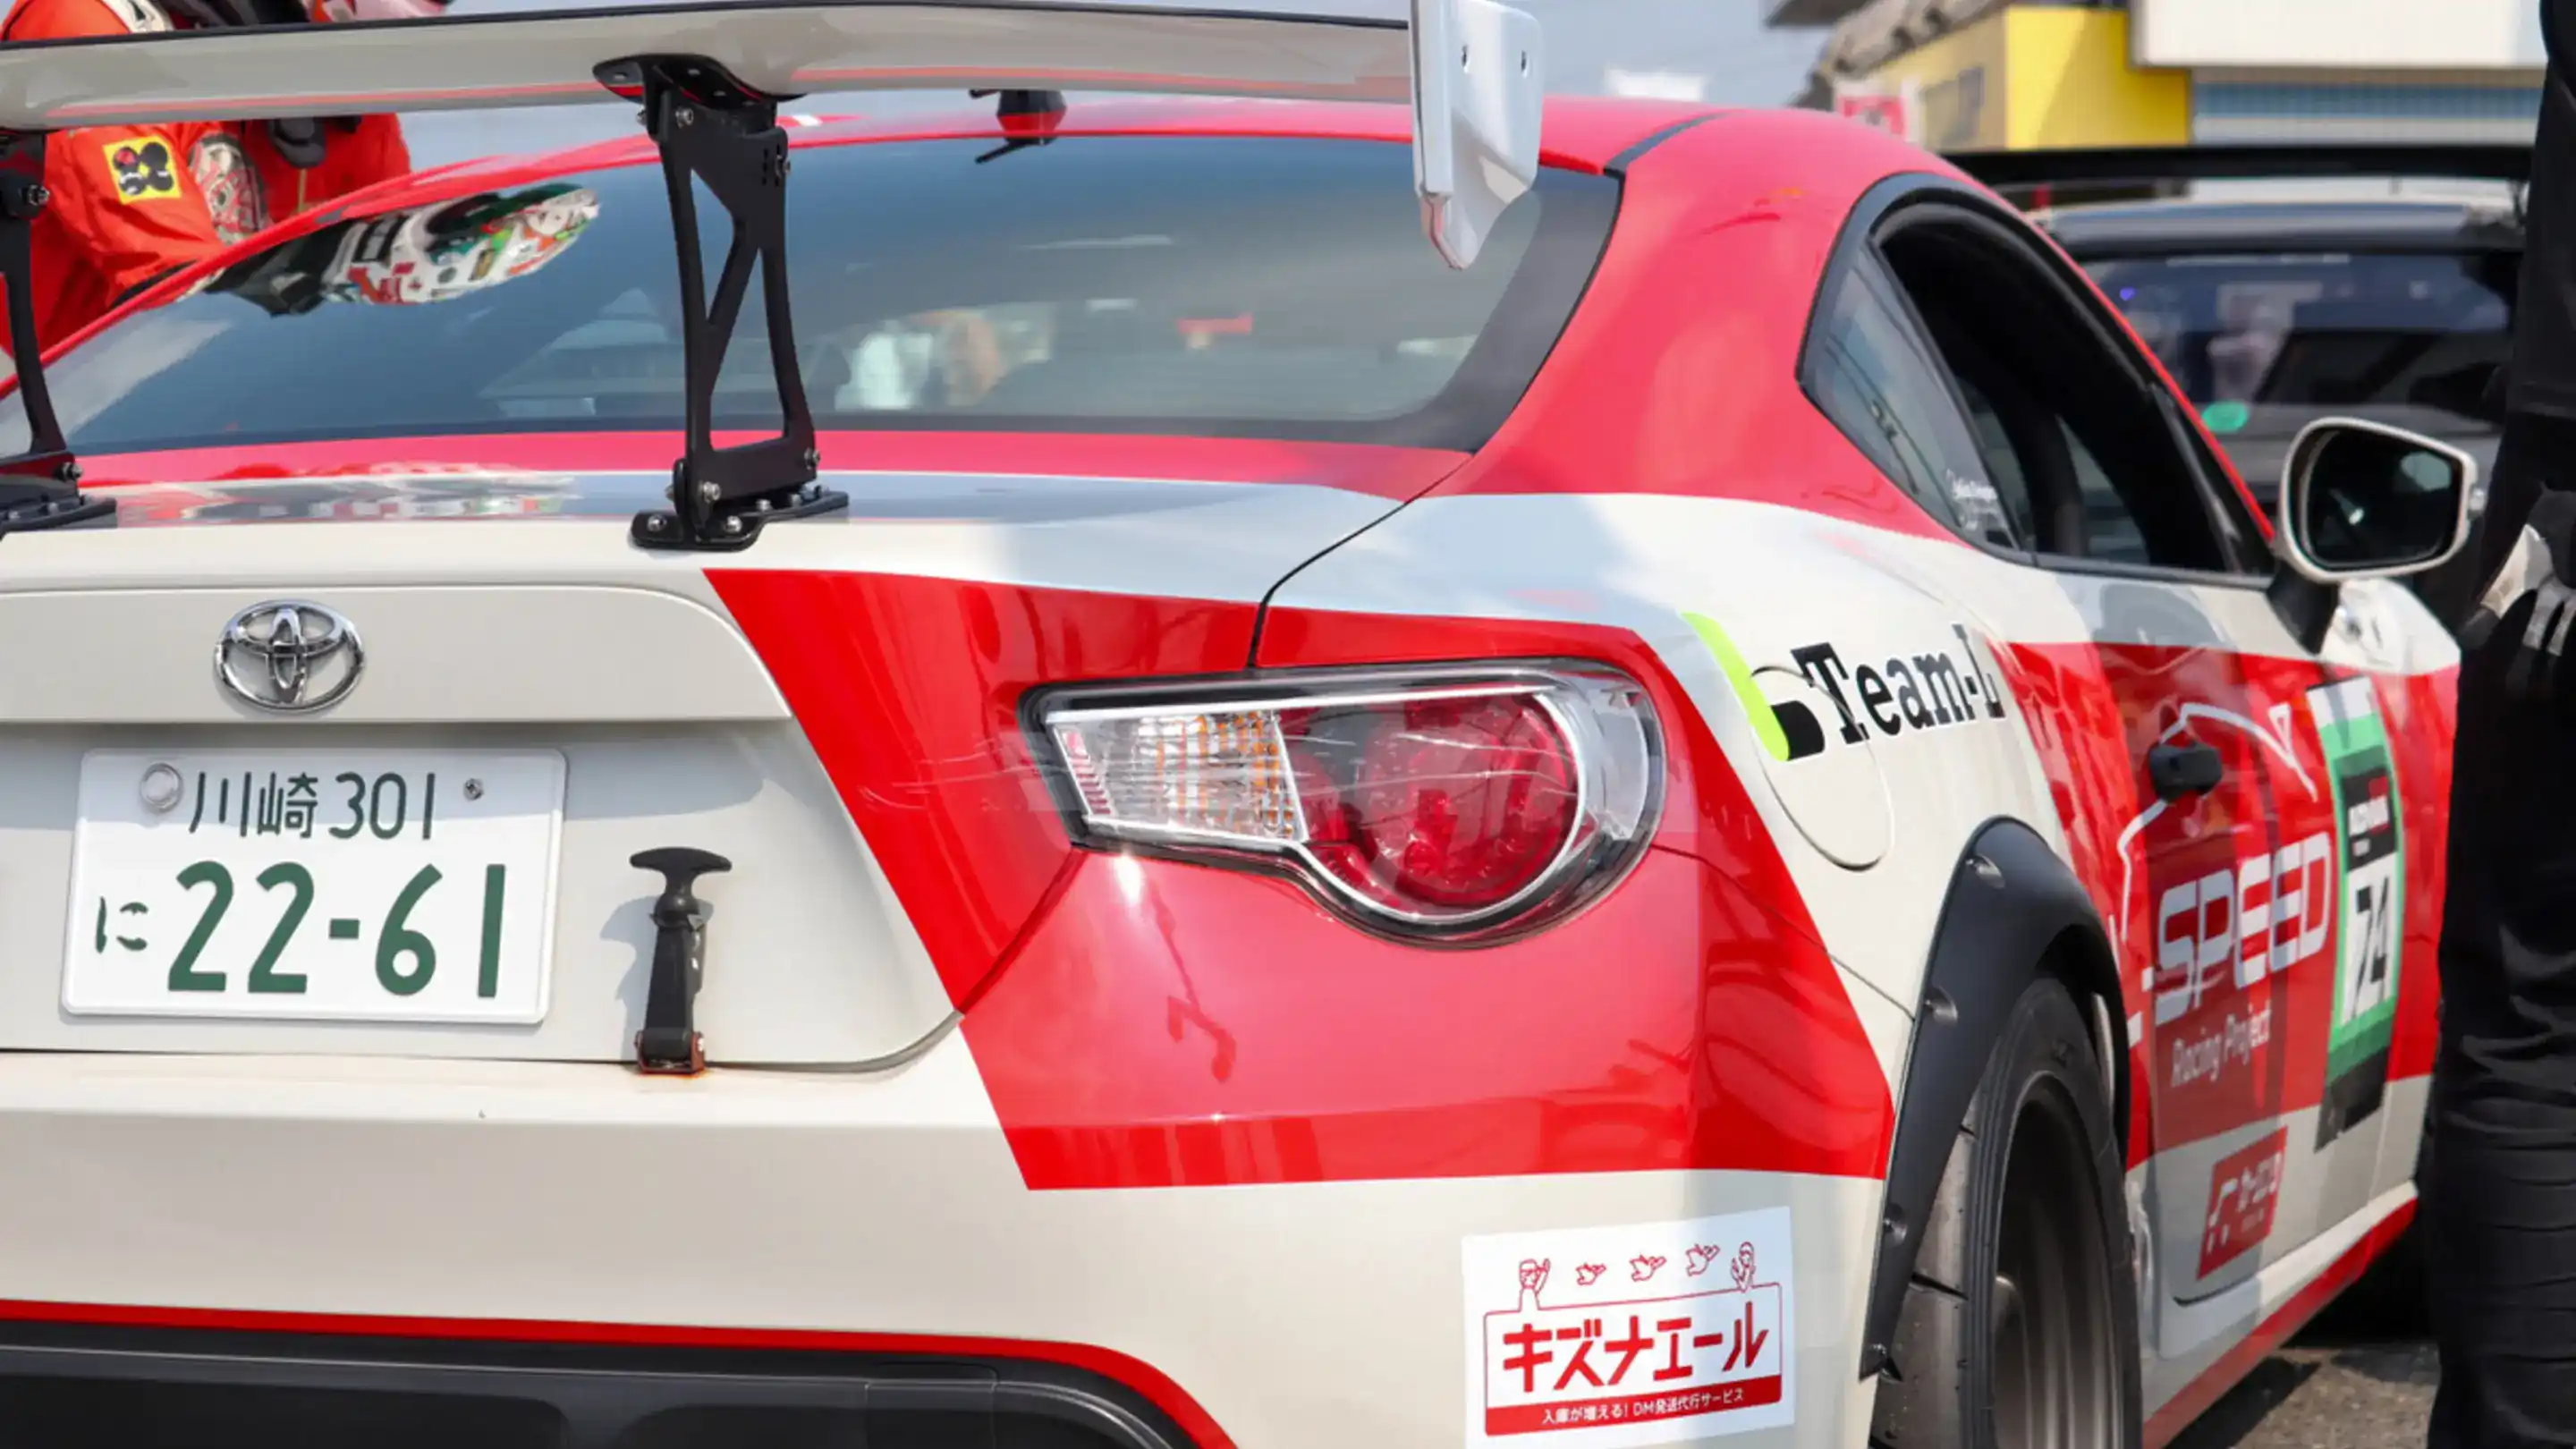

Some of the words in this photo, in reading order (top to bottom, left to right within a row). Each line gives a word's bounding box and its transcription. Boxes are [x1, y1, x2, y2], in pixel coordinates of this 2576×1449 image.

[189, 772, 318, 839] 川崎
[328, 772, 436, 840] 301
[96, 896, 148, 953] に
[168, 860, 507, 999] 22-61
[2155, 832, 2331, 1026] SPEED
[1503, 1301, 1769, 1394] キズナエール
